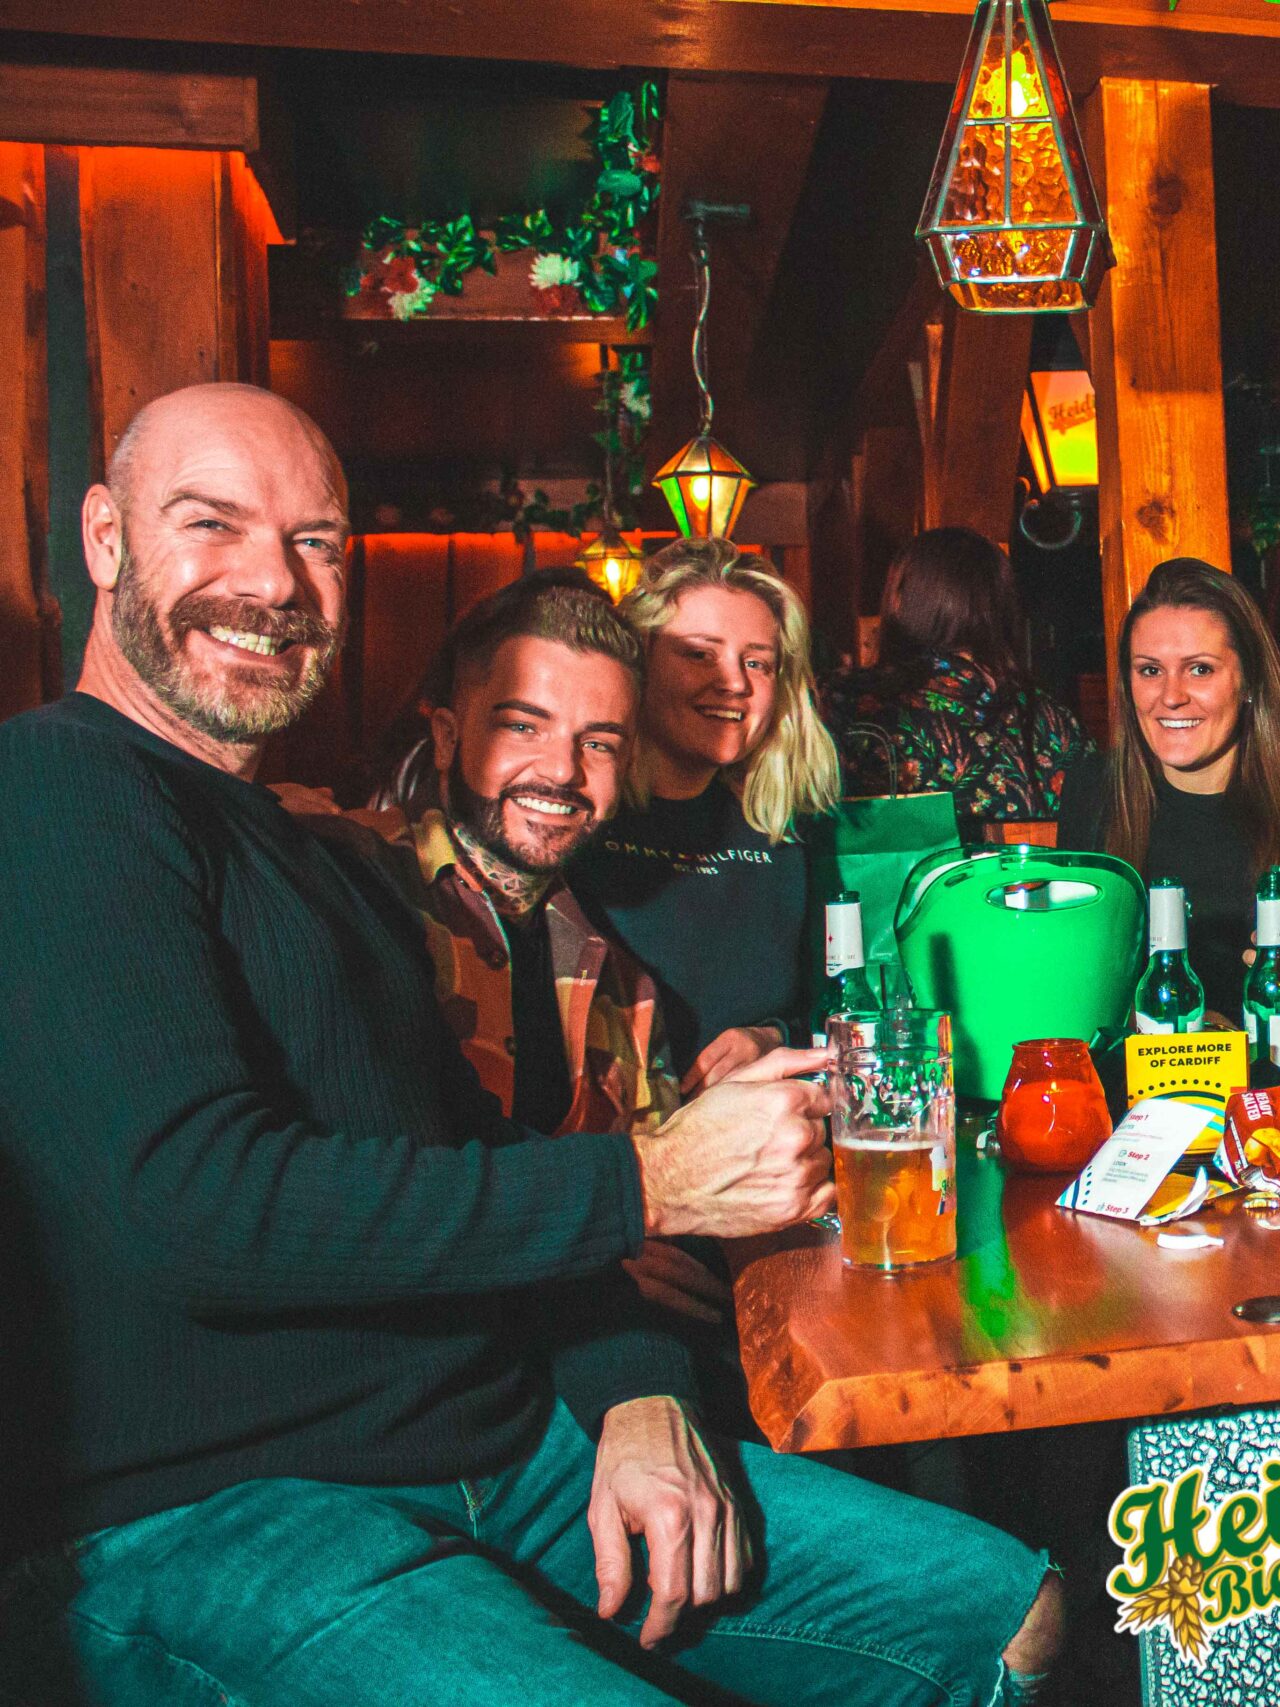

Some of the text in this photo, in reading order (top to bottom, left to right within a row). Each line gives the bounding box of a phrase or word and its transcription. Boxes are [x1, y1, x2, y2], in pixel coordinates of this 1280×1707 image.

[604, 840, 773, 864] OMMY HILFIGER
[1138, 1043, 1232, 1057] EXPLORE MORE
[1150, 1056, 1221, 1068] OF CARDIFF
[1241, 1092, 1262, 1121] SALTED
[1255, 1092, 1274, 1117] READY
[1127, 1151, 1150, 1161] Step 2
[1105, 1204, 1125, 1215] Step
